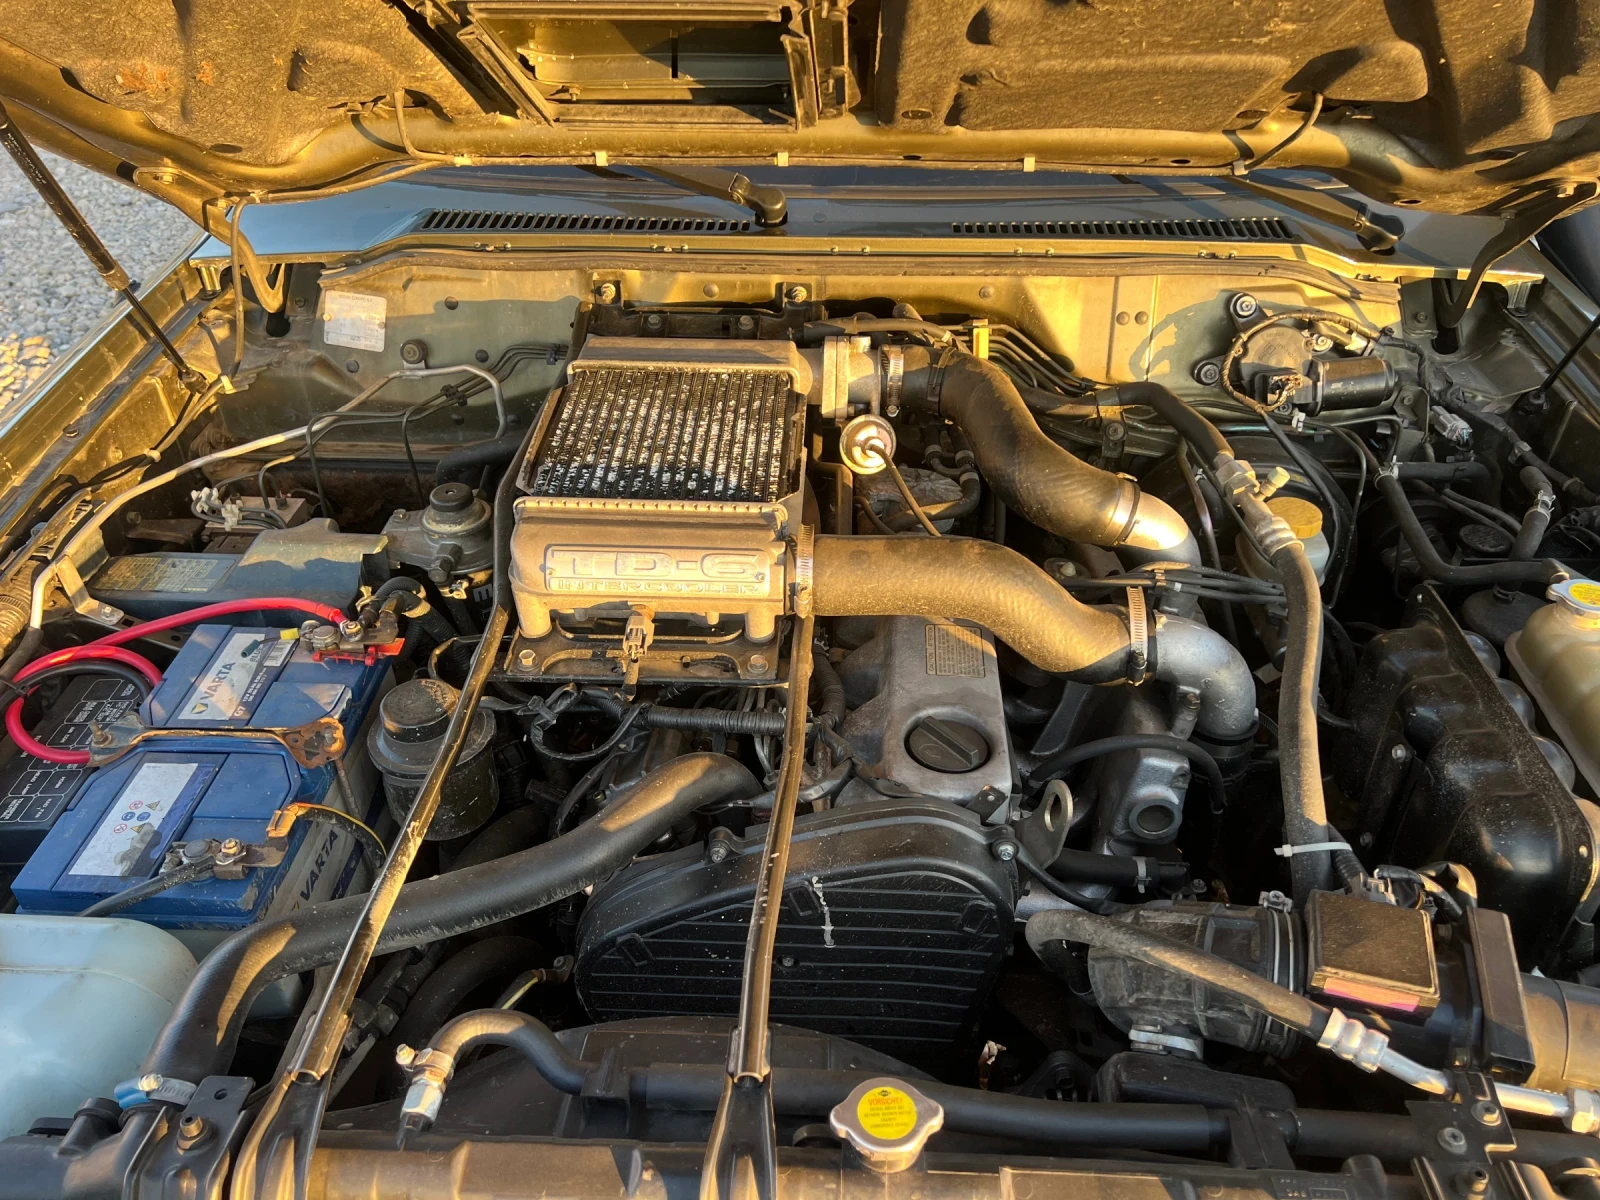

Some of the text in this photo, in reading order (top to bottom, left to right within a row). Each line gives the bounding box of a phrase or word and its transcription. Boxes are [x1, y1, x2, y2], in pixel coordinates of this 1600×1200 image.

[557, 579, 761, 595] INTERCOOLER
[200, 662, 236, 701] VARTA
[234, 705, 246, 717] G7
[300, 829, 338, 901] VARTA
